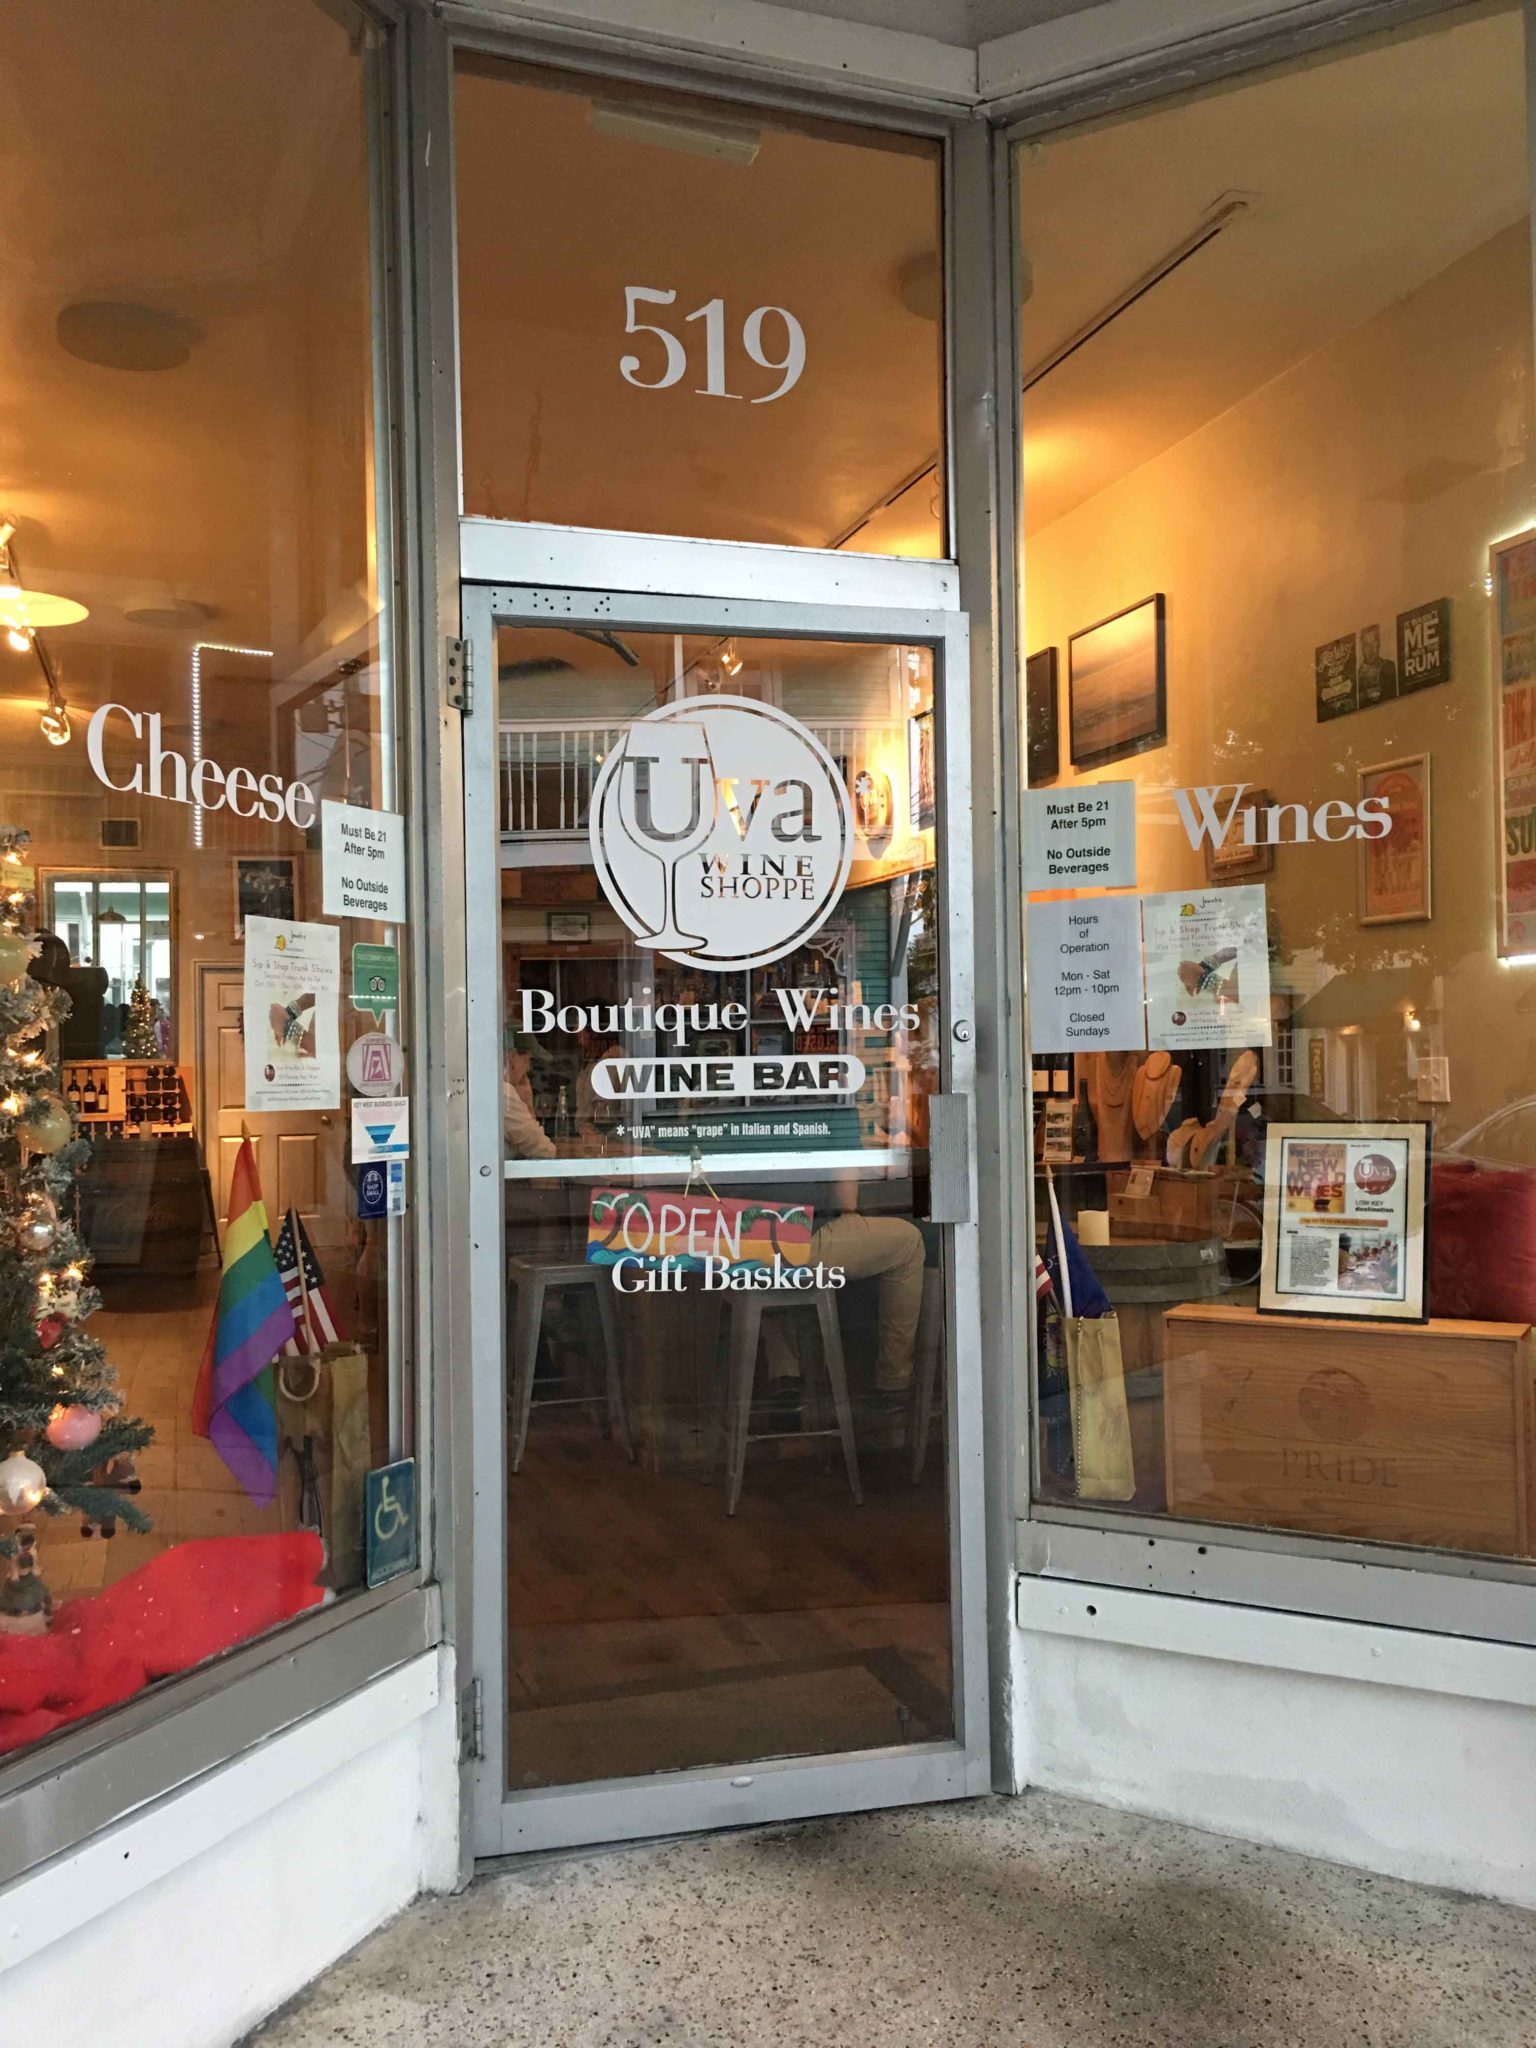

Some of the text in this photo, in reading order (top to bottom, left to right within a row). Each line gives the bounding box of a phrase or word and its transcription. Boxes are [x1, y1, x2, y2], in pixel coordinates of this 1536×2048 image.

[620, 286, 806, 404] 519
[1404, 618, 1439, 651] ME
[1405, 650, 1440, 677] RUM
[87, 703, 316, 829] Cheese
[622, 756, 822, 843] Uva
[1046, 800, 1109, 815] Must Be 21
[1051, 817, 1106, 830] After 5pm
[1173, 783, 1392, 850] Wines
[341, 823, 387, 843] Must Be 21
[343, 841, 385, 860] After 5pm
[1047, 846, 1111, 860] No Outside
[699, 852, 814, 877] WINE
[1049, 863, 1109, 875] Beverages
[341, 876, 388, 894] No Outside
[701, 876, 815, 901] SHOPPE
[343, 894, 388, 912] Beverages
[1069, 915, 1099, 925] Hours
[1079, 928, 1089, 939] of
[1180, 925, 1200, 935] Shop
[1060, 942, 1110, 955] Operation
[273, 960, 289, 971] Shop
[290, 961, 308, 972] Trunk
[312, 964, 333, 974] Shows
[1061, 971, 1083, 981] Mon
[1093, 969, 1111, 980] Sat
[1054, 986, 1082, 997] 12pm
[1092, 984, 1119, 995] 10pm
[516, 987, 921, 1047] Boutique Wines
[1069, 1012, 1105, 1023] Closed
[1066, 1026, 1110, 1038] Sundays
[606, 1061, 850, 1093] WINE BAR
[658, 1126, 689, 1137] means
[731, 1123, 739, 1135] in
[742, 1123, 771, 1135] Italian
[773, 1123, 790, 1135] and
[792, 1122, 831, 1136] Spanish.
[1298, 1159, 1338, 1172] NEW
[1359, 1161, 1391, 1177] Uva
[623, 1202, 742, 1259] OPEN
[612, 1254, 846, 1293] Gift Baskets
[1281, 1447, 1398, 1488] PRIDE
